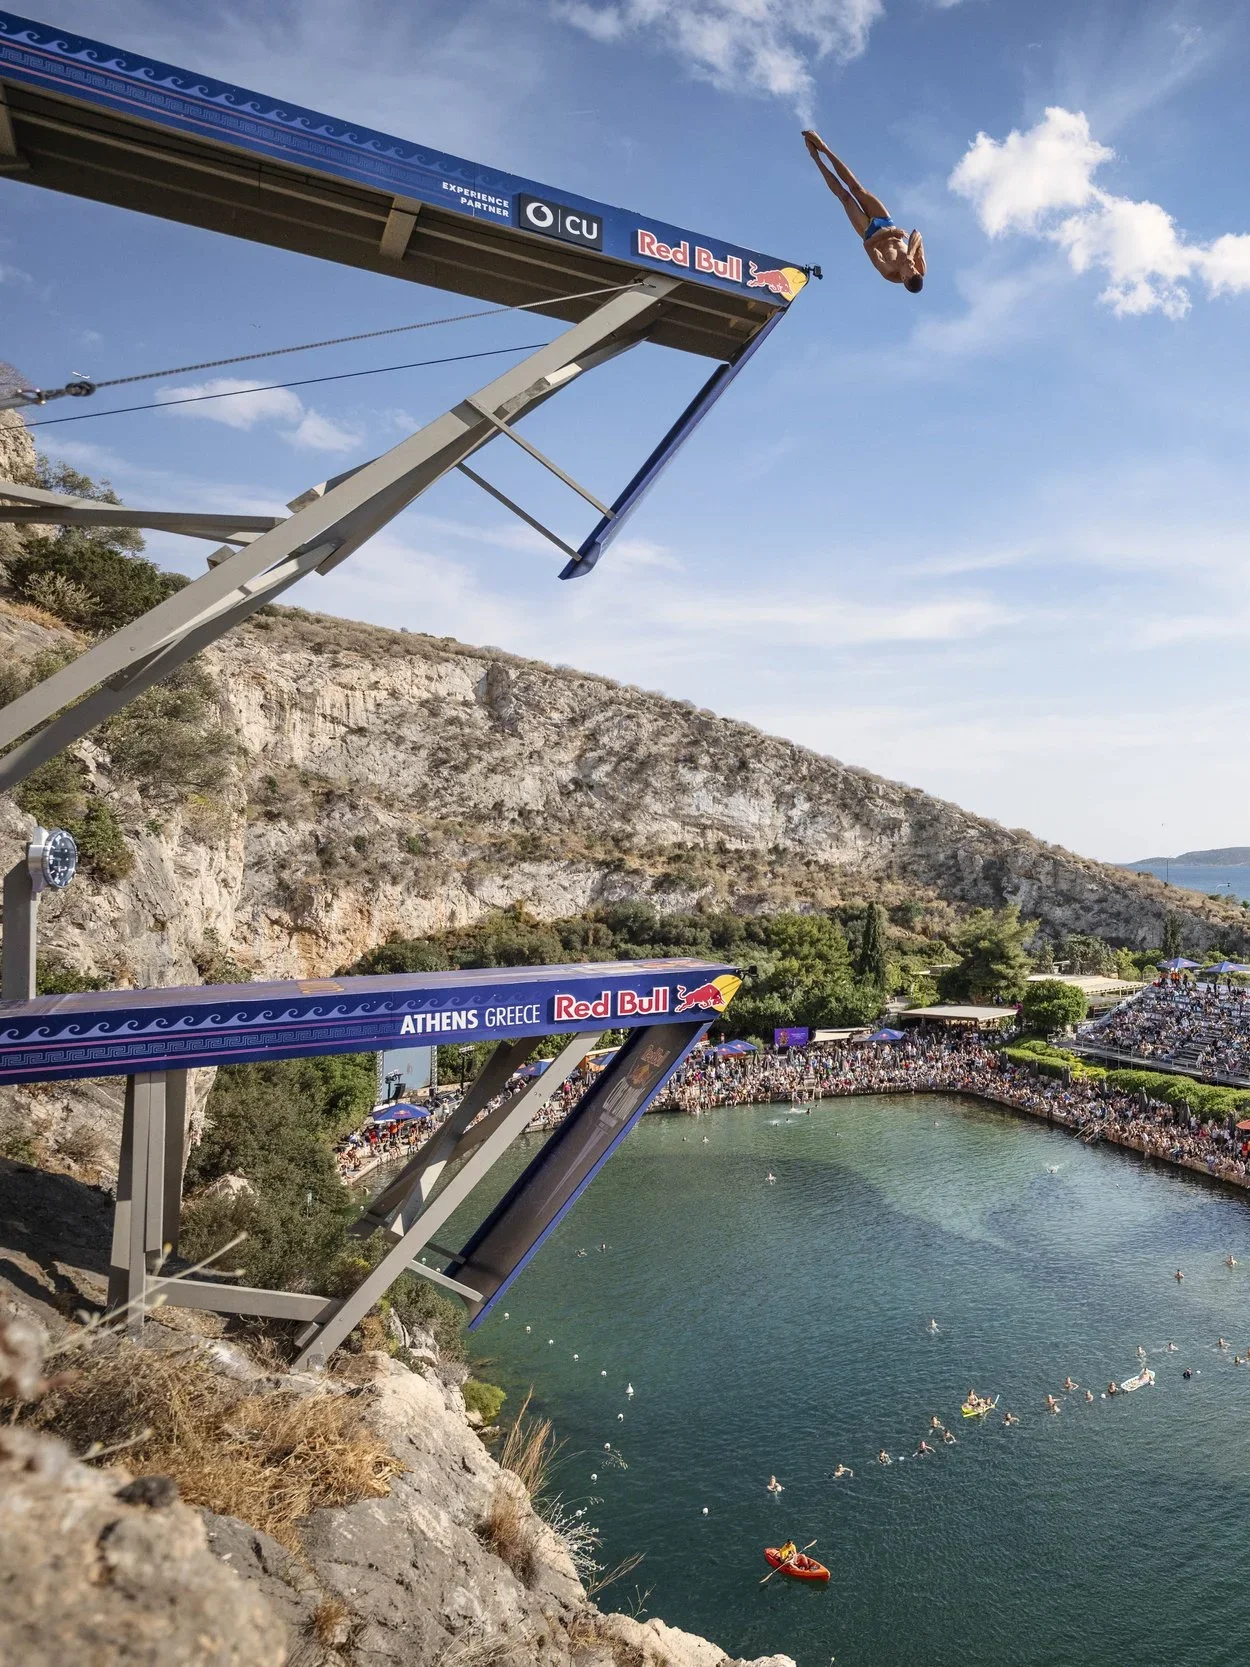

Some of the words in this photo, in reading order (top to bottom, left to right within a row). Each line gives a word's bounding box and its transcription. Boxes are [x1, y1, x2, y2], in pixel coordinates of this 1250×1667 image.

[442, 181, 509, 208] EXPERIENCE
[460, 197, 509, 218] PARTNER
[565, 215, 598, 240] CU
[638, 229, 689, 267] Red
[695, 246, 742, 282] Bull
[554, 990, 611, 1021] Red
[617, 987, 670, 1016] Bull
[400, 1009, 479, 1035] ATHENS
[485, 1004, 541, 1027] GREECE
